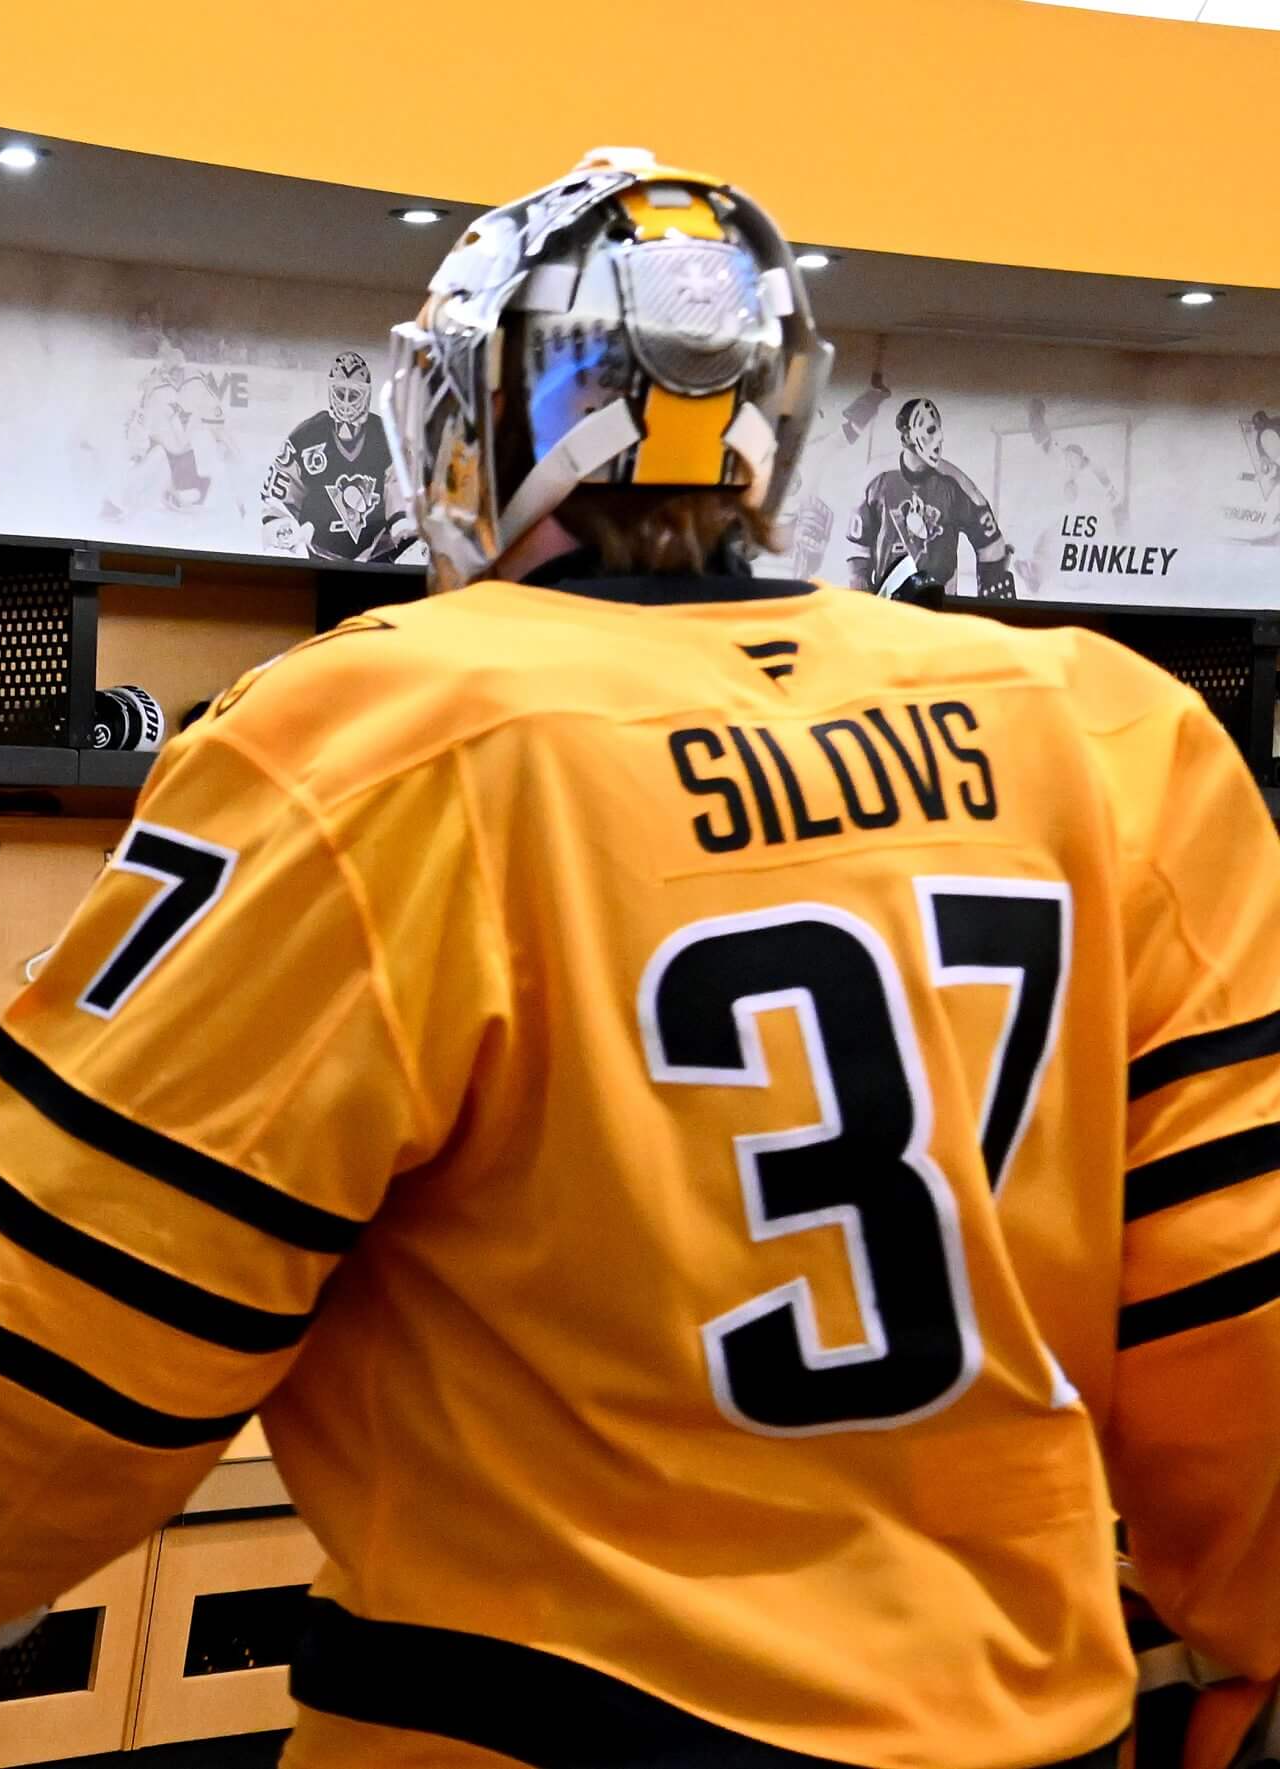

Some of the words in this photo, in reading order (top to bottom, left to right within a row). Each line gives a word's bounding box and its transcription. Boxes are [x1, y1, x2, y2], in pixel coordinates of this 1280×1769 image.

[1060, 543, 1178, 576] BINKLEY
[1061, 515, 1098, 538] LES
[667, 699, 999, 855] SILOVS
[637, 874, 1073, 1438] 37
